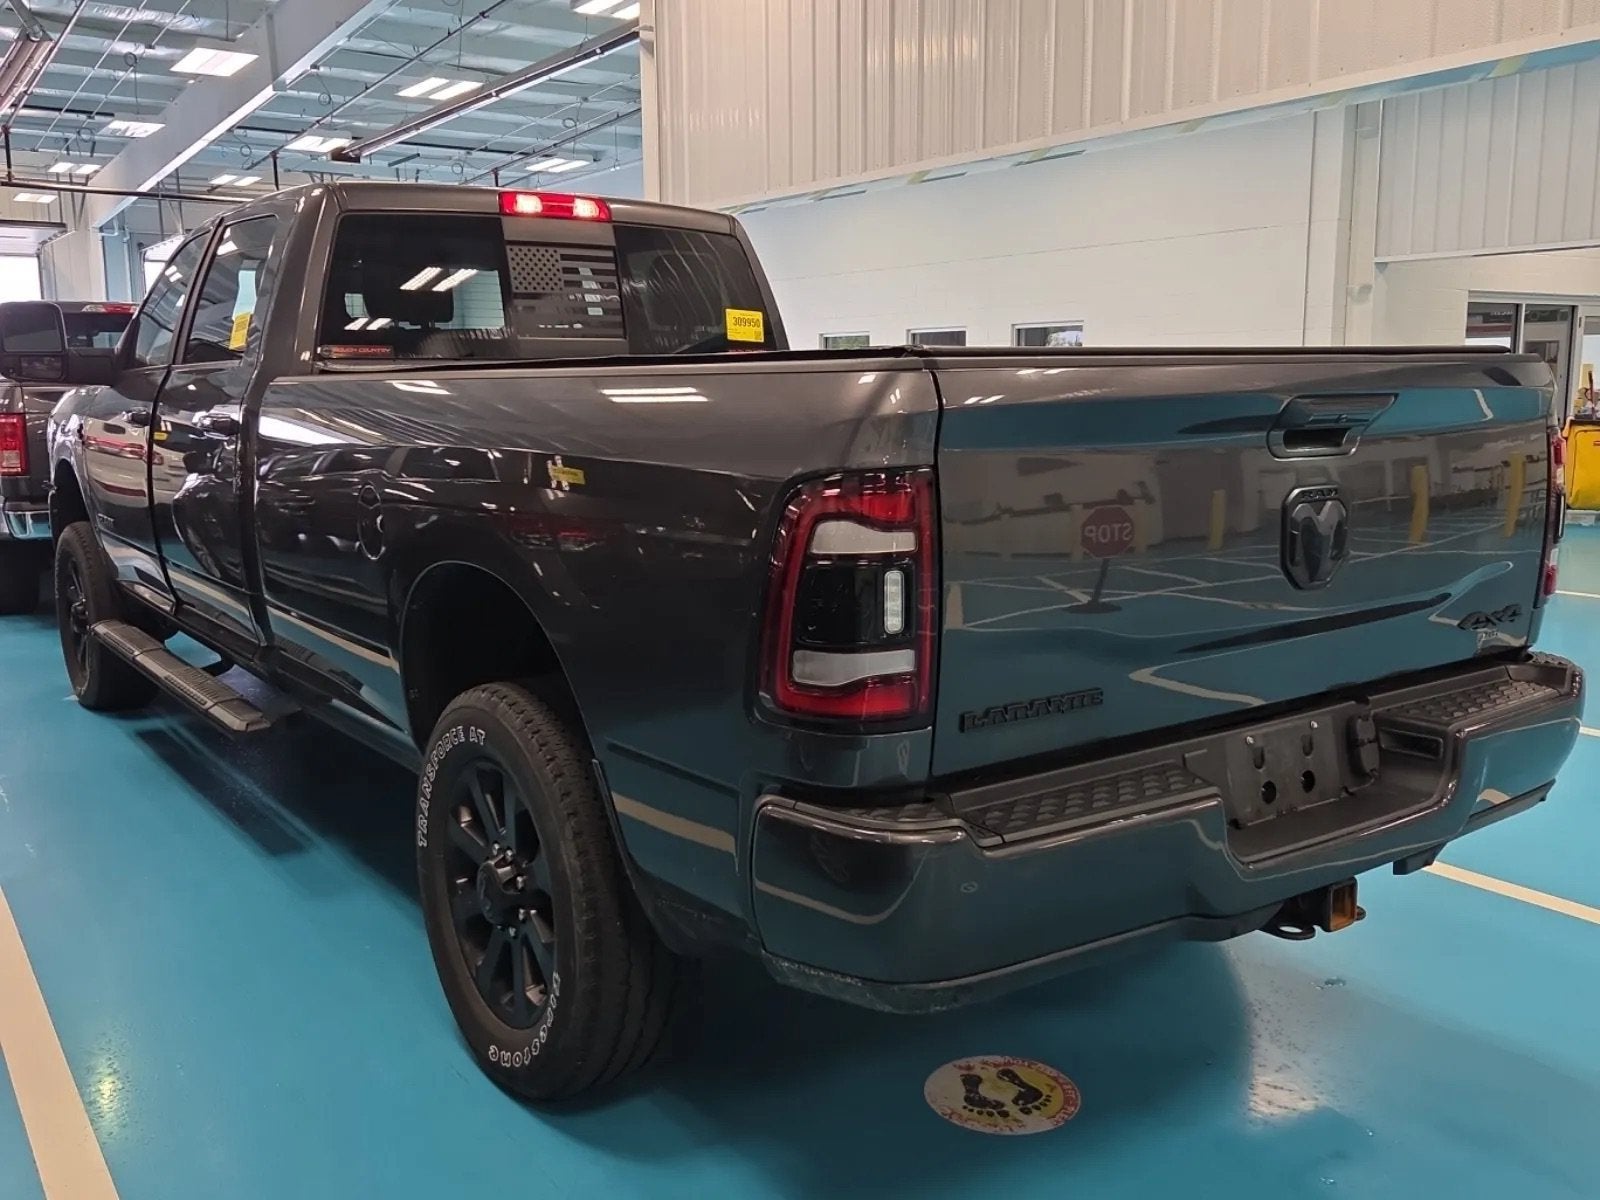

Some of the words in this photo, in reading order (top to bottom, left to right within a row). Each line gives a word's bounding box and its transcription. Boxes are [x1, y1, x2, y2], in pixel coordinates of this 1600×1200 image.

[958, 687, 1104, 733] LARAMIE
[417, 725, 465, 848] TRANSFORCE
[469, 726, 486, 746] AT
